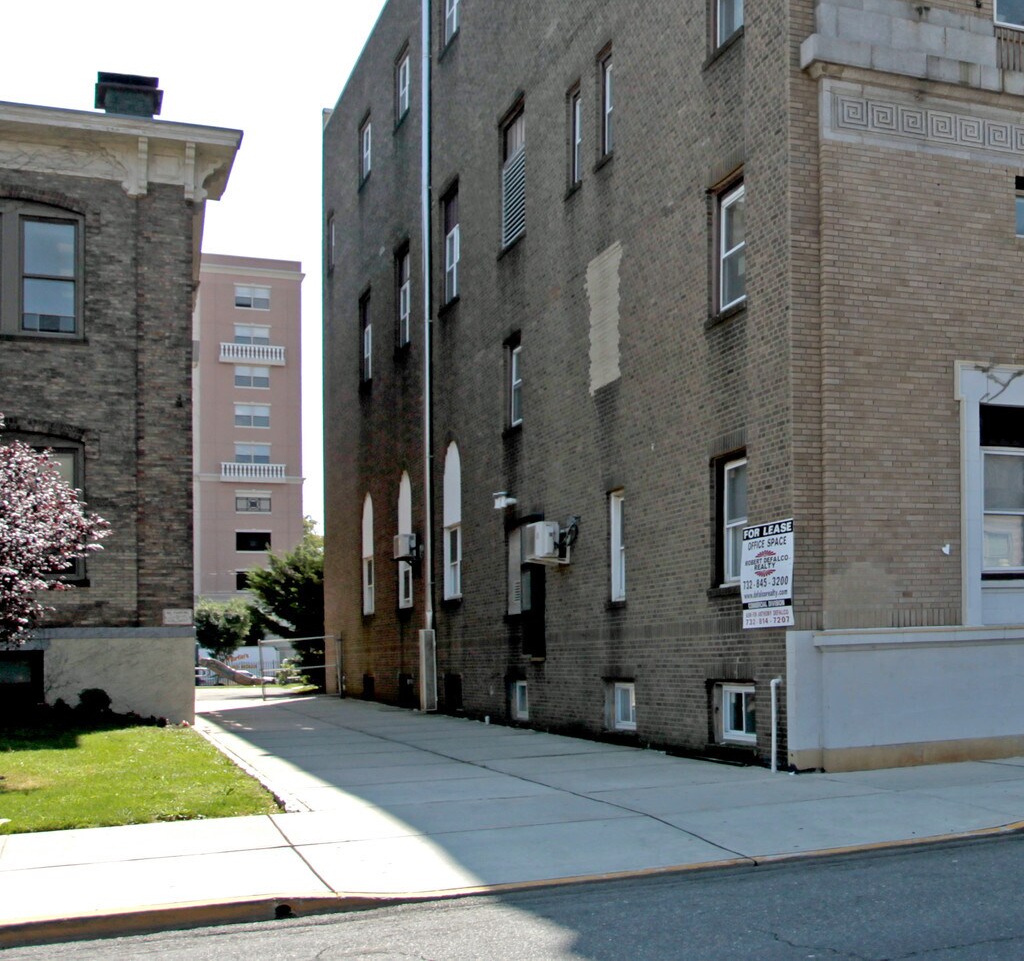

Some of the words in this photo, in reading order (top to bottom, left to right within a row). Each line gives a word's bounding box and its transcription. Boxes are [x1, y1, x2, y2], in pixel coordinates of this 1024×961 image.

[743, 528, 760, 539] FOR
[763, 521, 792, 536] LEASE
[748, 539, 765, 550] OFFICE
[767, 535, 787, 547] SPACE
[745, 558, 762, 566] ROBERT
[763, 554, 789, 564] DEFALCO
[754, 562, 776, 570] REALTY
